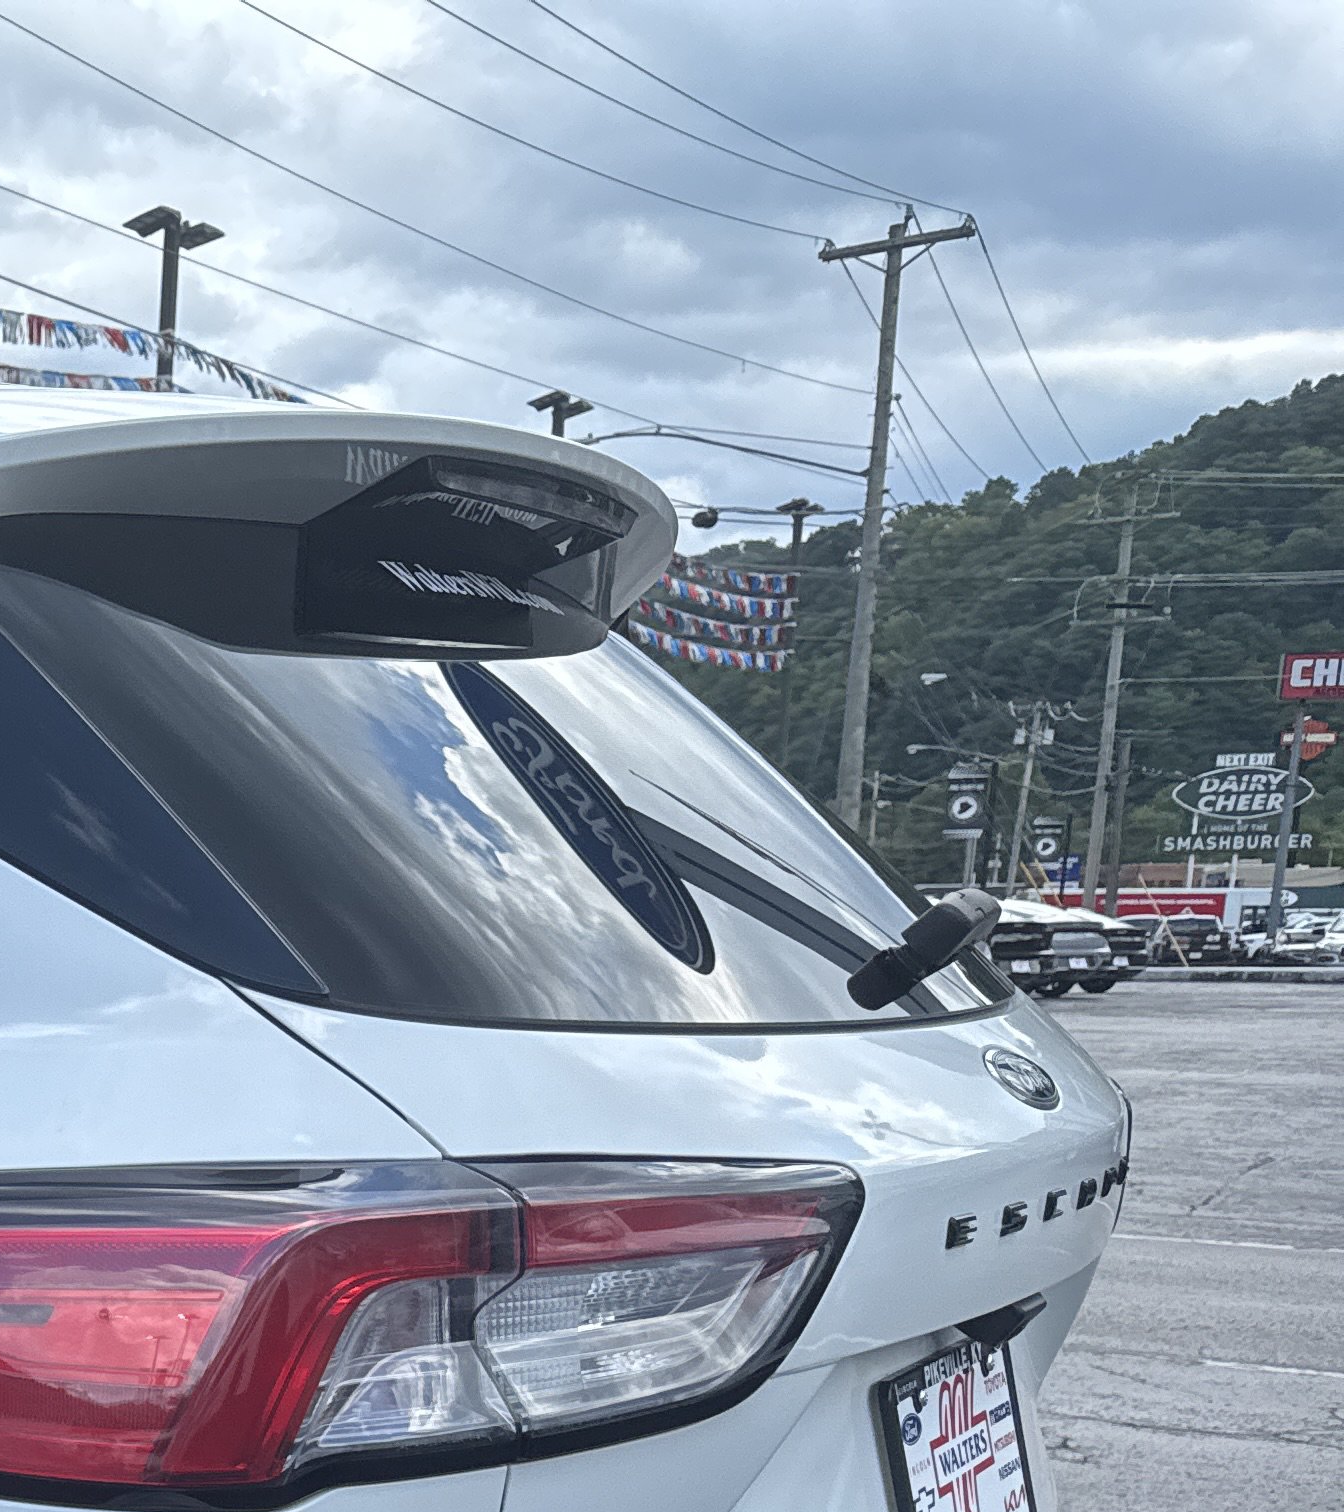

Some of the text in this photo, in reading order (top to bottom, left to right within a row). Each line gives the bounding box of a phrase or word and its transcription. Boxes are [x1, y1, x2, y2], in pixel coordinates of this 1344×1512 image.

[1216, 752, 1276, 767] NEXT EXIT
[1199, 773, 1286, 793] DAIRY
[1198, 793, 1284, 813] CHEER
[938, 1428, 987, 1476] WALTERS
